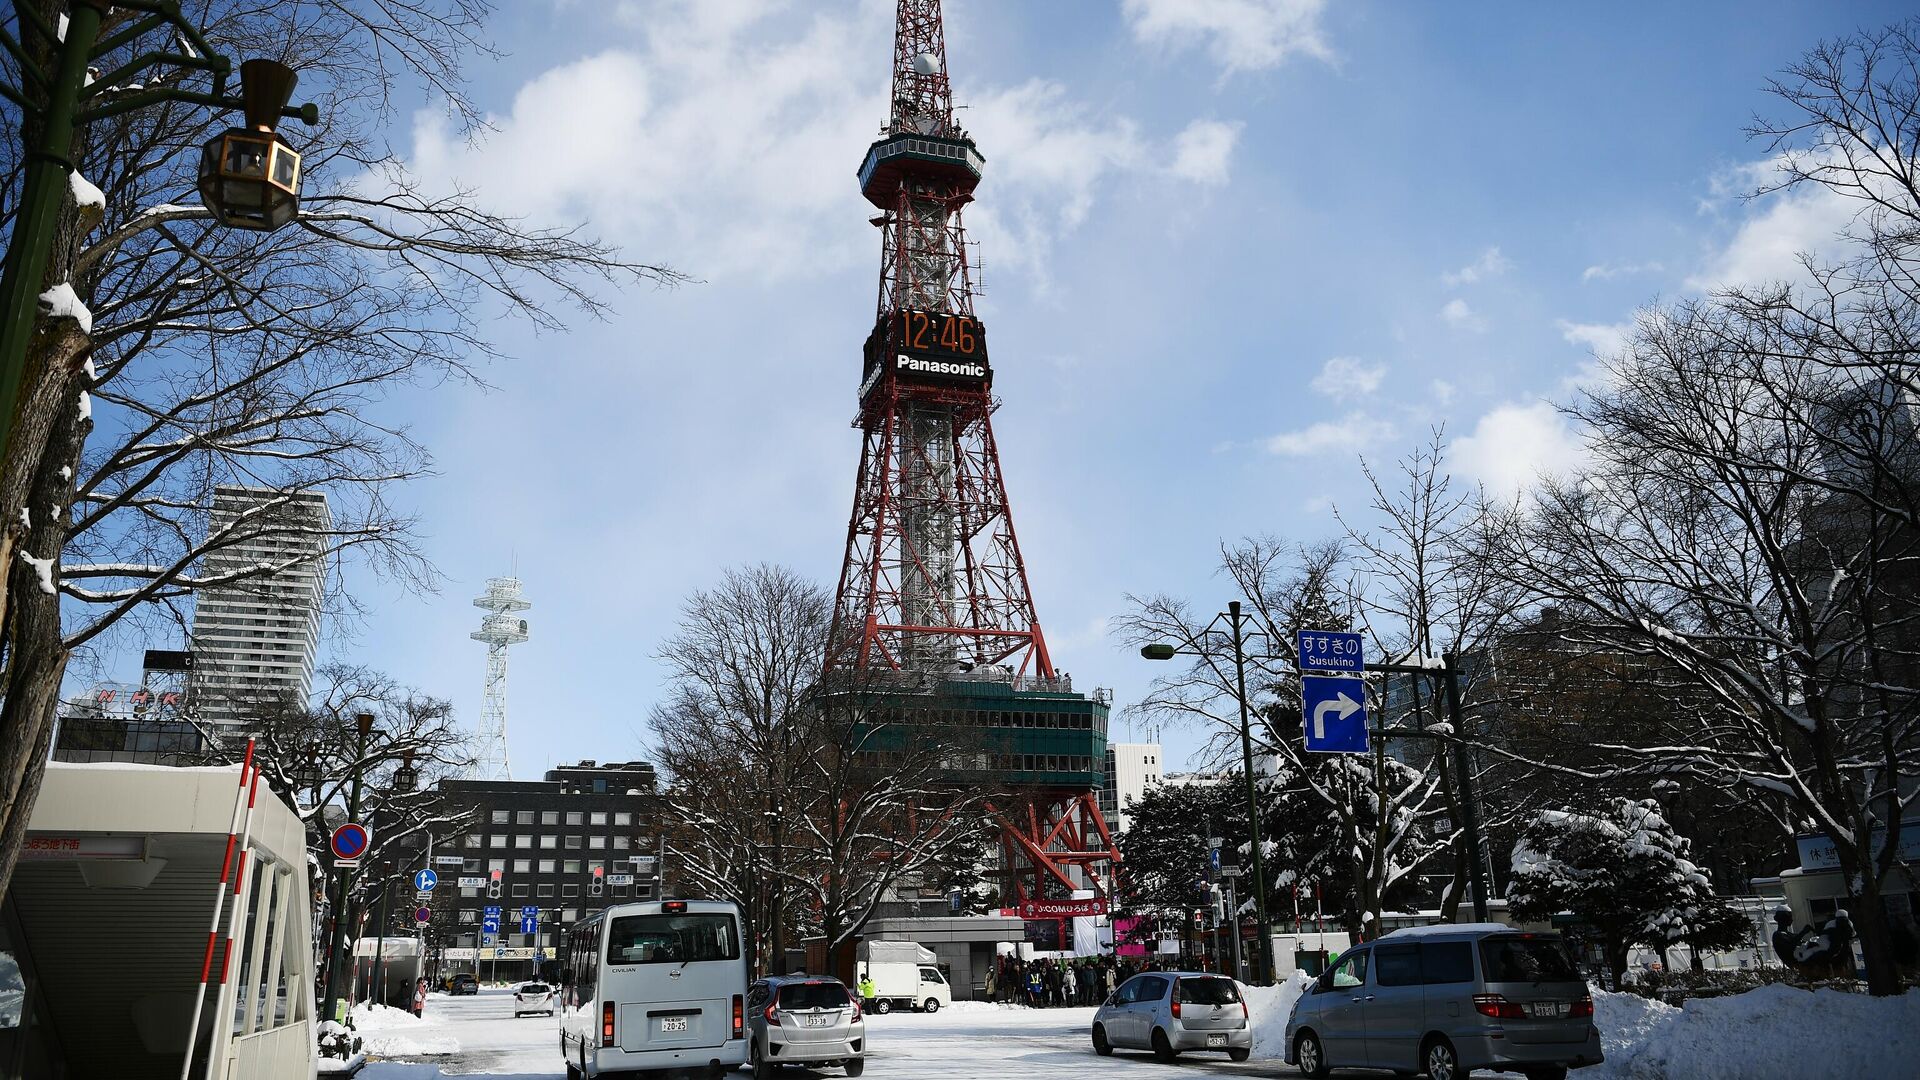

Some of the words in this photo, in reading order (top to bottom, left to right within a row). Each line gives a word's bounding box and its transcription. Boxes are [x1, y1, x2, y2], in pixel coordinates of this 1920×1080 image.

[902, 312, 976, 354] 12:46
[897, 354, 985, 377] Panasonic
[1302, 635, 1358, 655] すすきの
[1308, 655, 1355, 667] Susukino
[98, 689, 180, 705] NHK
[1038, 904, 1093, 913] J:COMひろば
